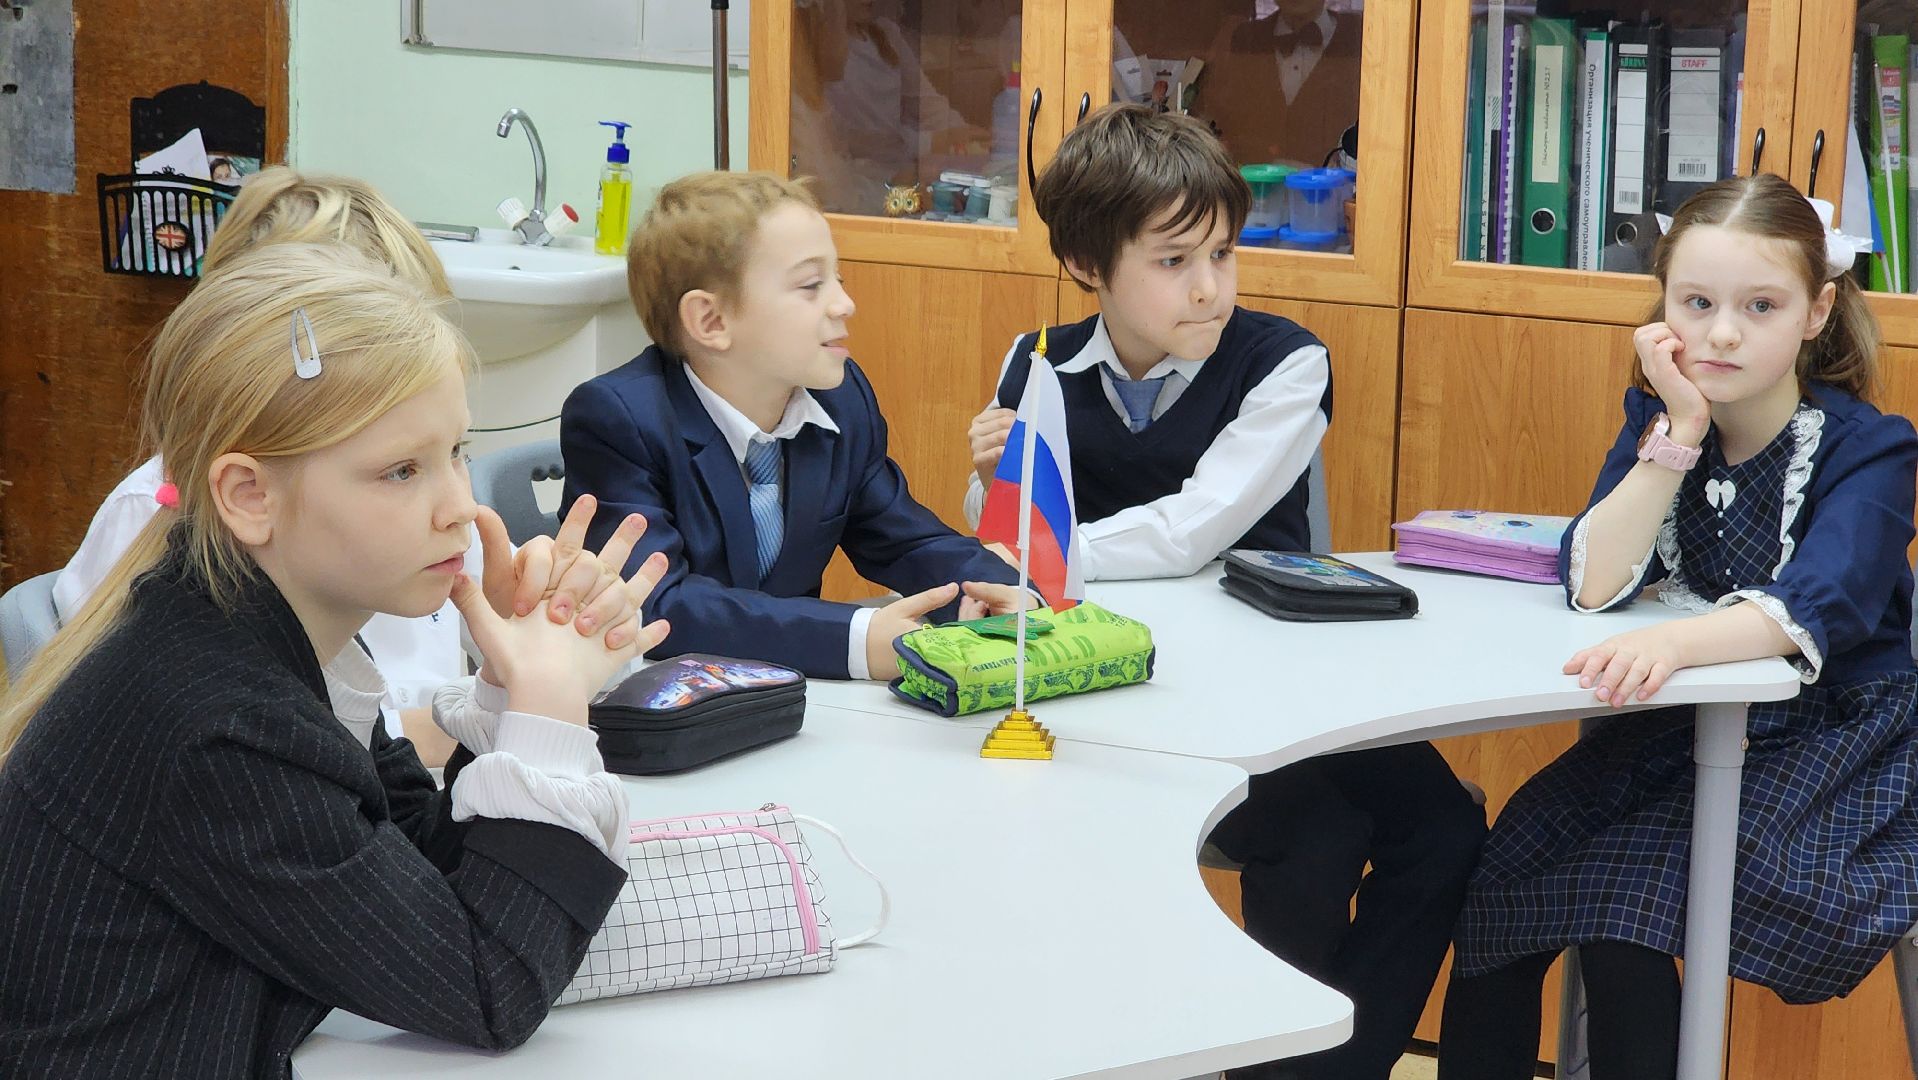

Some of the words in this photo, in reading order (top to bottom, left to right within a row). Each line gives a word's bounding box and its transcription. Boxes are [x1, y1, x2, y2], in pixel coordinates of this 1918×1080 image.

[1681, 59, 1708, 68] STAFF
[1587, 64, 1596, 128] Организация
[1584, 130, 1592, 196] ученического
